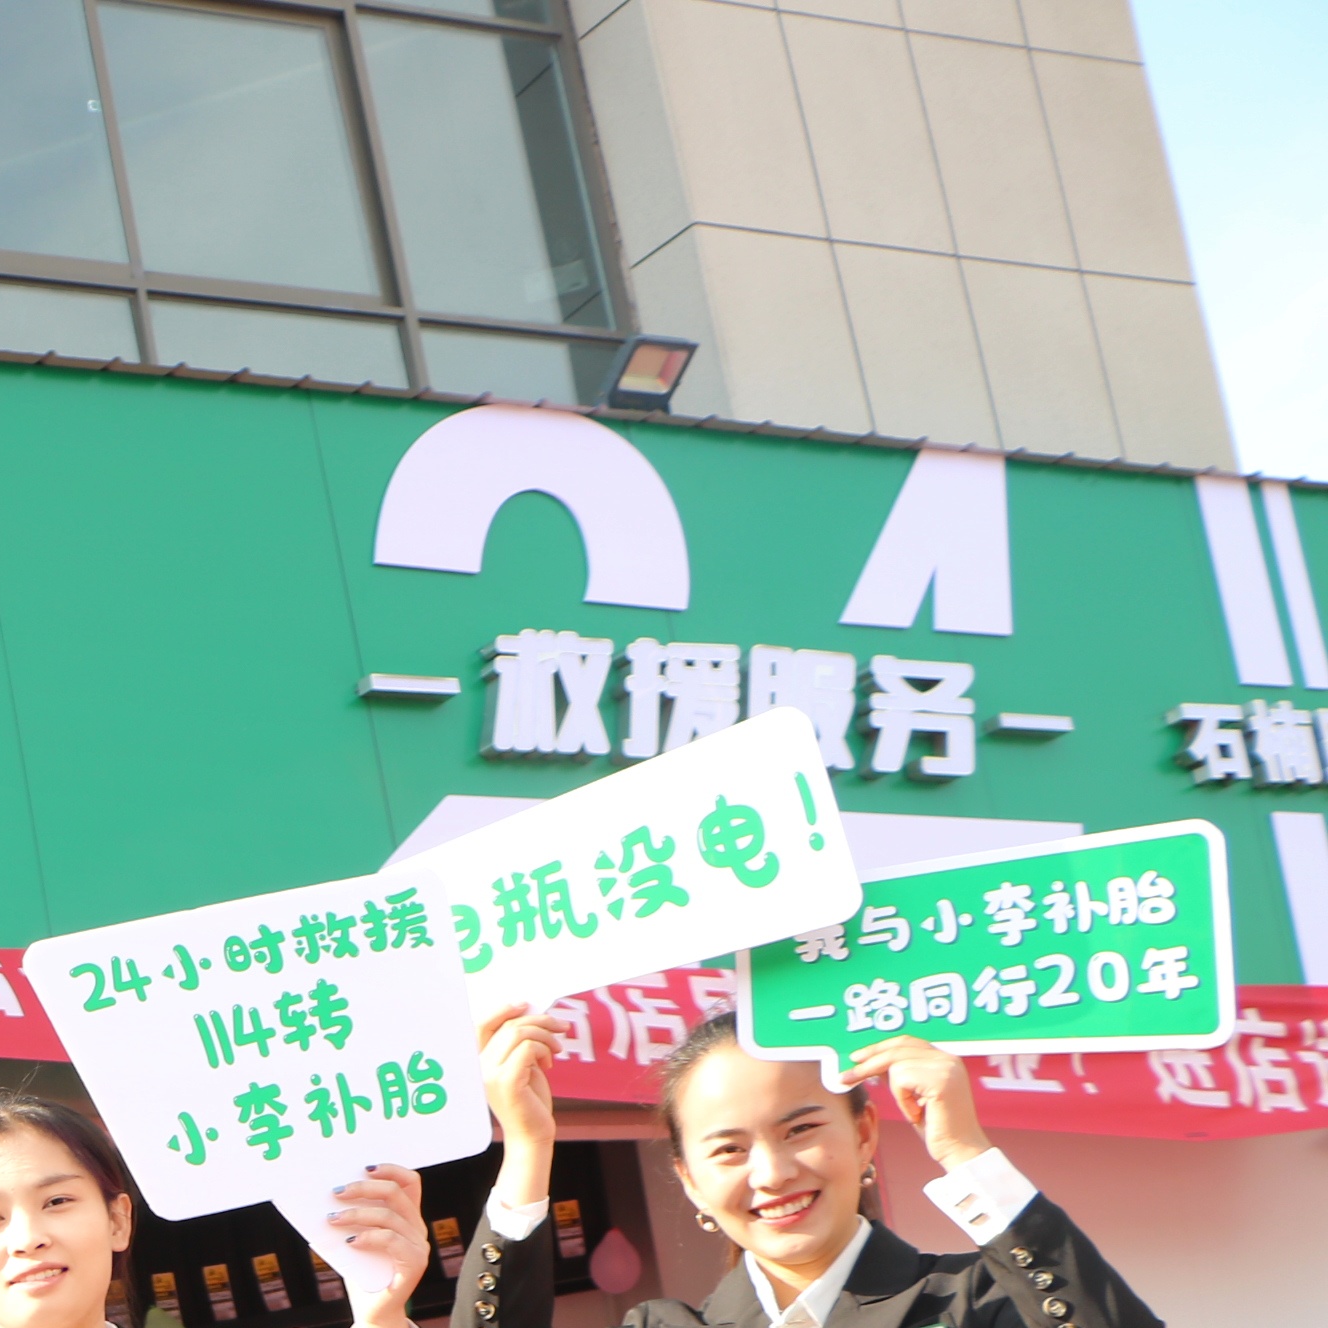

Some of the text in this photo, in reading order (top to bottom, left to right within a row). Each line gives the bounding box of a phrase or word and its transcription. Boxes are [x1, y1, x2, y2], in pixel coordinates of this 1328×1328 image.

[484, 629, 976, 776] 救援服务
[1170, 699, 1328, 785] 石楠
[68, 887, 434, 1012] 24小时救援
[788, 945, 1200, 1034] 一路同行20年
[192, 977, 354, 1069] 114转
[166, 1050, 449, 1167] 小李补胎
